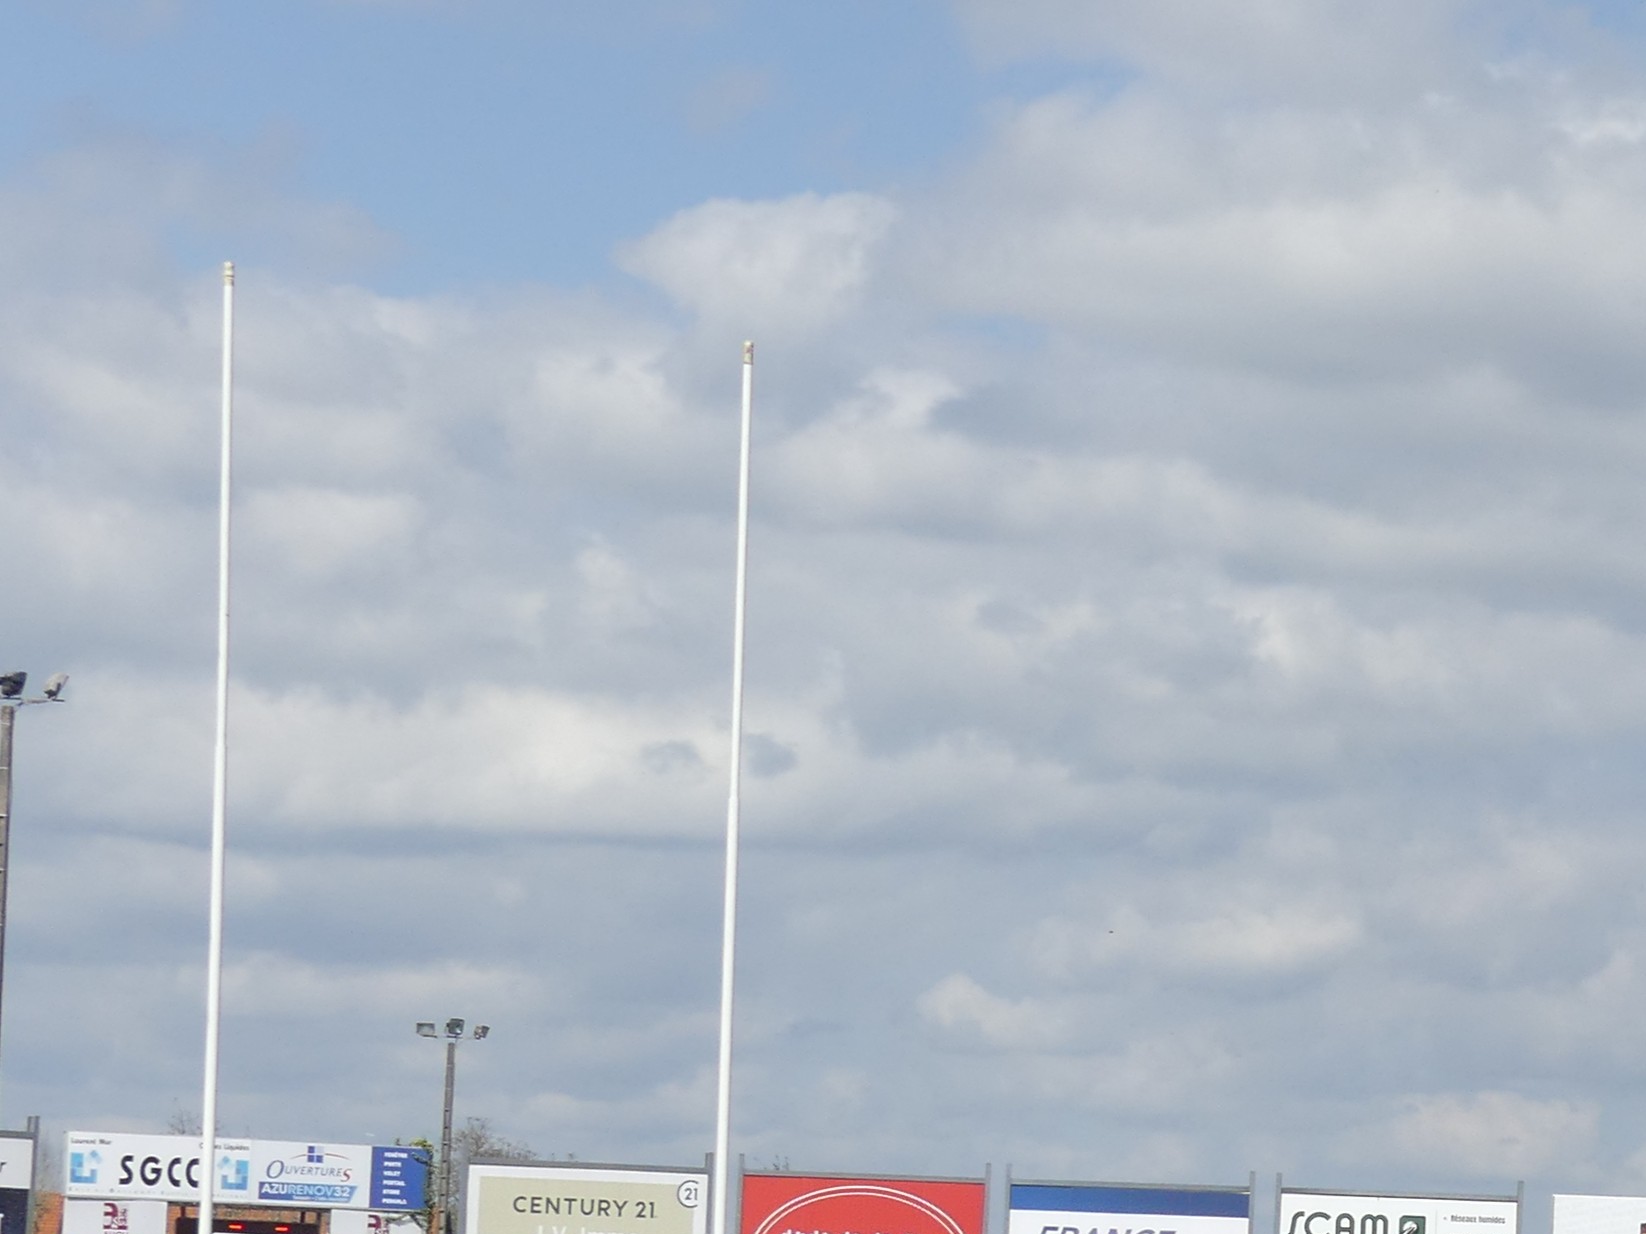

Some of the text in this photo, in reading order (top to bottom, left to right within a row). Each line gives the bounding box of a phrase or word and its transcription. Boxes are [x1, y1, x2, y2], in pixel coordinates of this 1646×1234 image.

[261, 1182, 351, 1197] AZURENOV32
[513, 1195, 657, 1218] CENTURY 21
